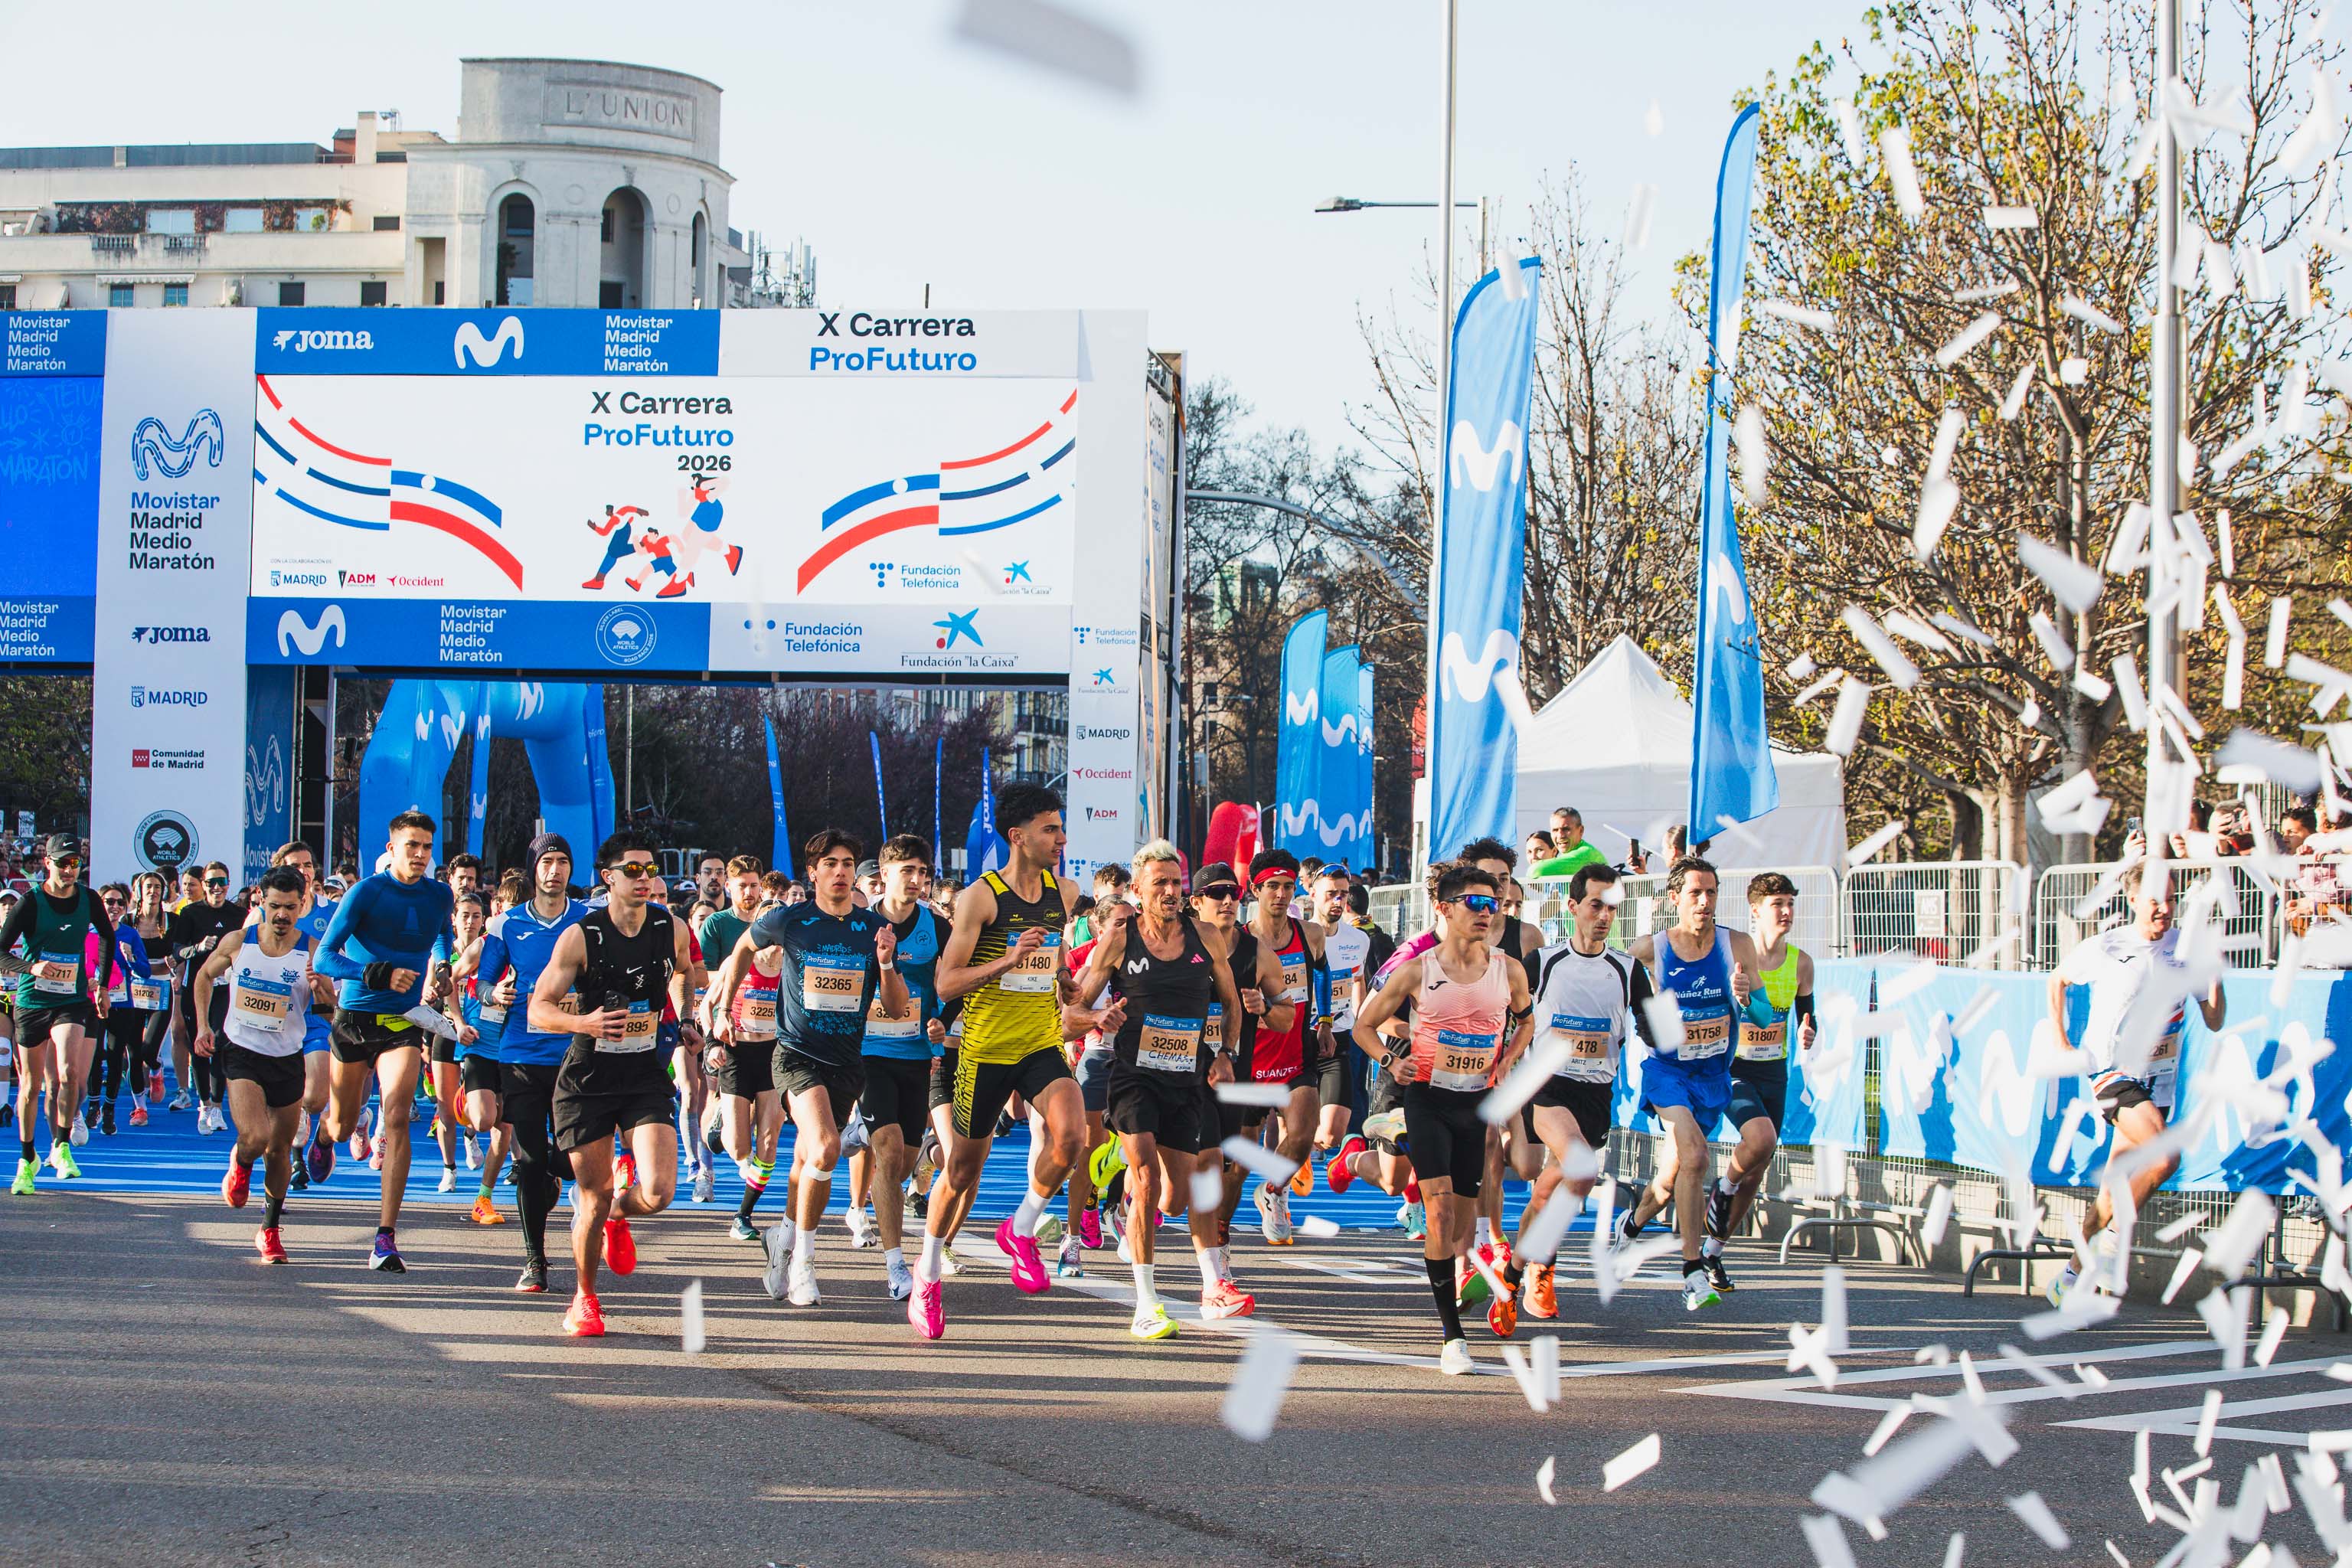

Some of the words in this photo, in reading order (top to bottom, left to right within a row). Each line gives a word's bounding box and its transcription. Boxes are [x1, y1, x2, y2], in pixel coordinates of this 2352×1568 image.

[566, 91, 685, 126] L'UNION
[9, 316, 70, 329] Movistar
[606, 315, 672, 329] Movistar
[818, 313, 841, 337] X
[850, 312, 975, 337] Carrera
[8, 330, 58, 343] Madrid
[605, 330, 660, 344] Madrid
[8, 345, 51, 357] Medio
[604, 345, 652, 358] Medio
[7, 357, 66, 371] Maratón
[604, 358, 668, 373] Maratón
[810, 348, 977, 371] ProFuturo
[590, 392, 612, 415] X
[619, 392, 733, 415] Carrera
[584, 423, 733, 446] ProFuturo
[678, 455, 732, 472] 2026
[132, 492, 220, 510] Movistar
[130, 512, 203, 530] Madrid
[129, 532, 192, 550] Medio
[129, 550, 215, 570] Maratón
[901, 564, 961, 576] Fundación
[283, 573, 327, 587] MADRID
[348, 573, 376, 583] ADM
[399, 575, 444, 587] Occident
[901, 577, 959, 589] Telefónica
[0, 602, 59, 614] Movistar
[440, 605, 506, 620] Movistar
[0, 616, 47, 628] Madrid
[440, 619, 494, 634] Madrid
[786, 621, 863, 637] Fundación
[0, 631, 40, 642] Medio
[1095, 628, 1138, 636] Fundación
[439, 634, 486, 648] Medio
[785, 638, 861, 653] Telefónica
[1095, 637, 1137, 645] Telefónica
[0, 643, 55, 657] Maratón
[439, 647, 503, 663] Maratón
[901, 654, 962, 668] Fundación
[149, 691, 208, 707] MADRID
[1088, 729, 1130, 740] MADRID
[152, 750, 205, 759] Comunidad
[152, 760, 165, 769] de
[168, 760, 204, 769] Madrid
[1085, 769, 1132, 779] Occident
[1093, 809, 1118, 818] ADM
[137, 822, 149, 841] SILVER
[149, 813, 164, 824] LABEL
[179, 858, 192, 872] RACE
[807, 955, 837, 964] ProFuturo
[51, 969, 71, 978] 717
[1282, 973, 1298, 985] 84
[240, 977, 265, 988] ProFuturo
[814, 976, 852, 991] 32365
[135, 989, 154, 998] 31202
[1704, 988, 1722, 996] Run
[244, 996, 276, 1013] 32091
[876, 1007, 910, 1018] 325
[626, 1021, 649, 1033] 895
[1145, 1015, 1174, 1025] ProFuturo
[1553, 1016, 1583, 1026] ProFuturo
[1206, 1024, 1220, 1037] 81
[1439, 1031, 1470, 1043] ProFuturo
[1687, 1026, 1722, 1040] 31758
[1748, 1031, 1778, 1041] 31807
[1151, 1036, 1188, 1050] 32508
[2153, 1043, 2169, 1057] 261
[1446, 1054, 1485, 1070] 31916
